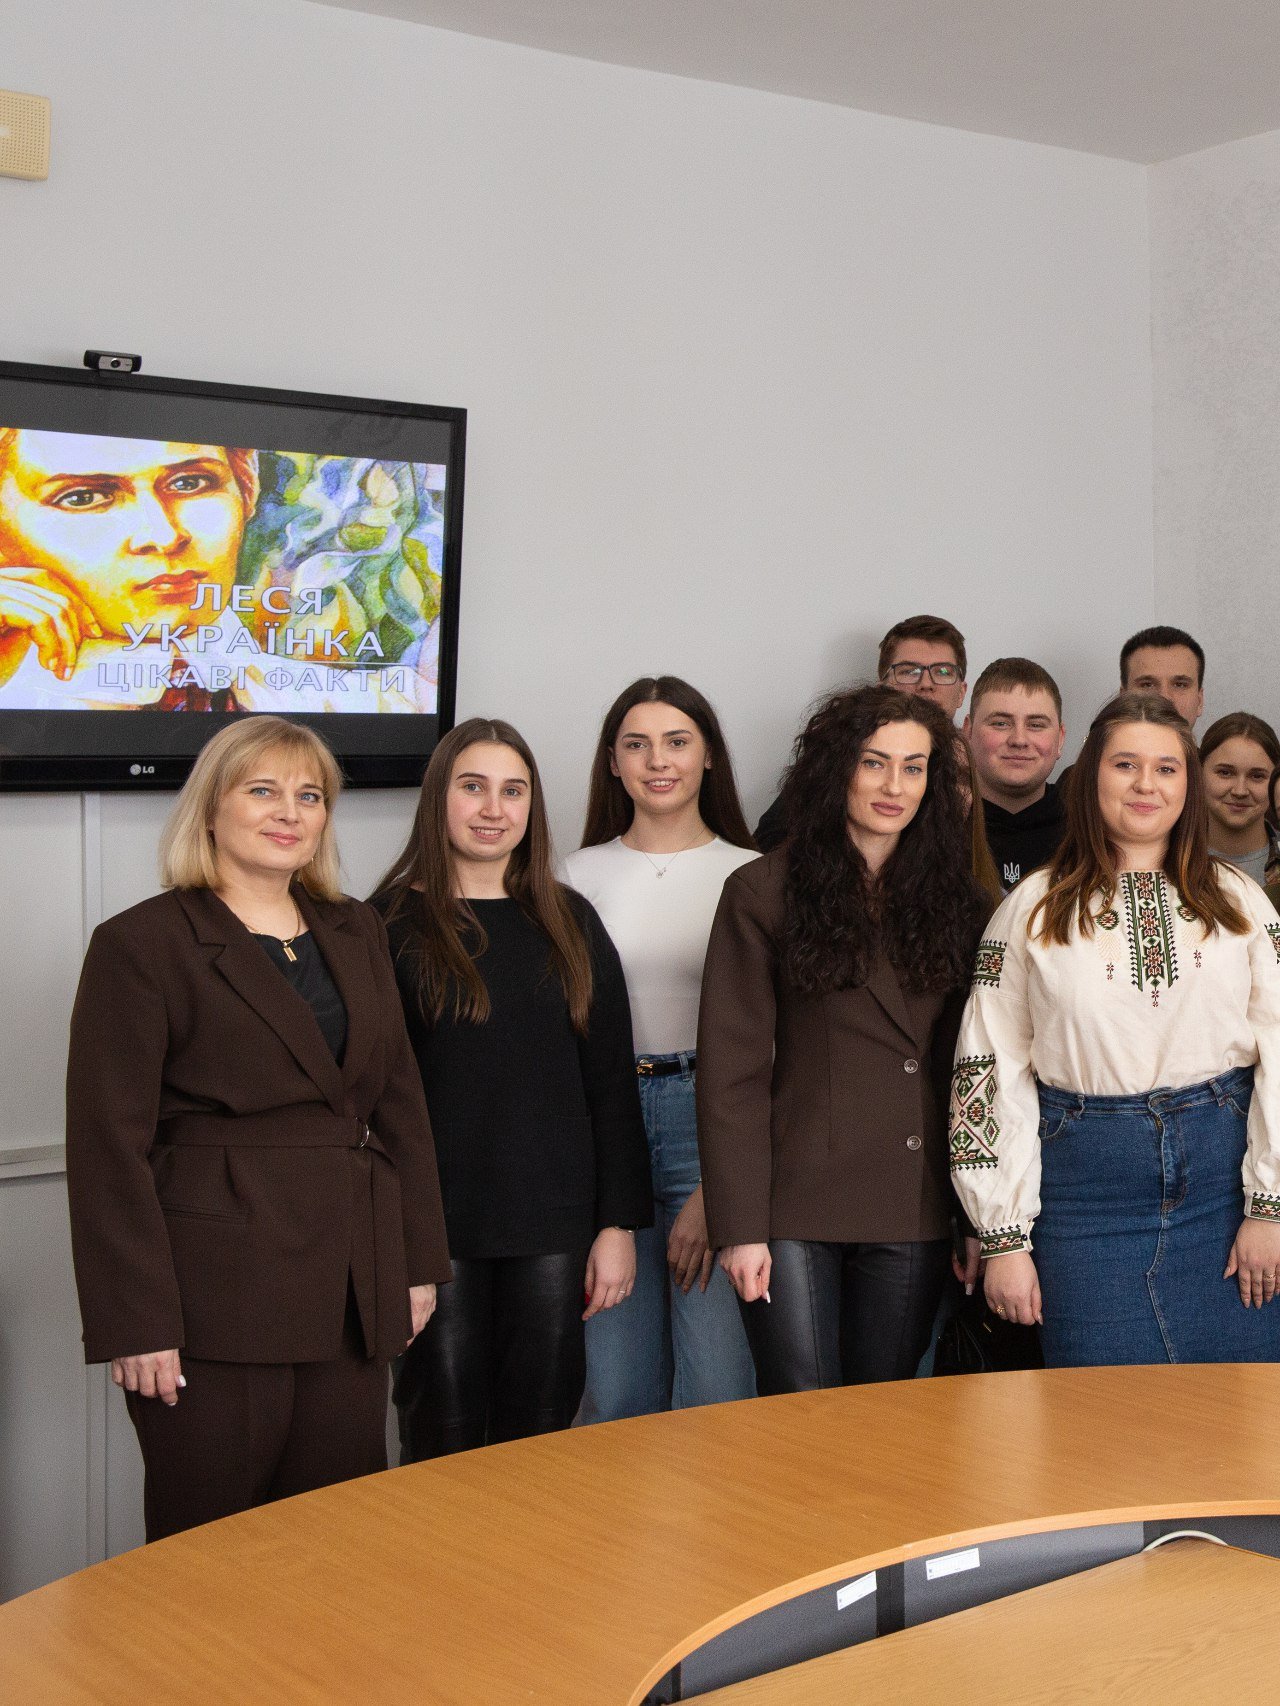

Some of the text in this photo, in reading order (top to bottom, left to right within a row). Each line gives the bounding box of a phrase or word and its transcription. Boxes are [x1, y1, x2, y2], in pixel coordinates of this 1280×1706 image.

[189, 584, 324, 615] ЛЕСЯ
[121, 621, 386, 657] УКРАЇНКА
[97, 662, 406, 693] ЦІКАВІ ФАКТИ
[142, 765, 155, 774] LG
